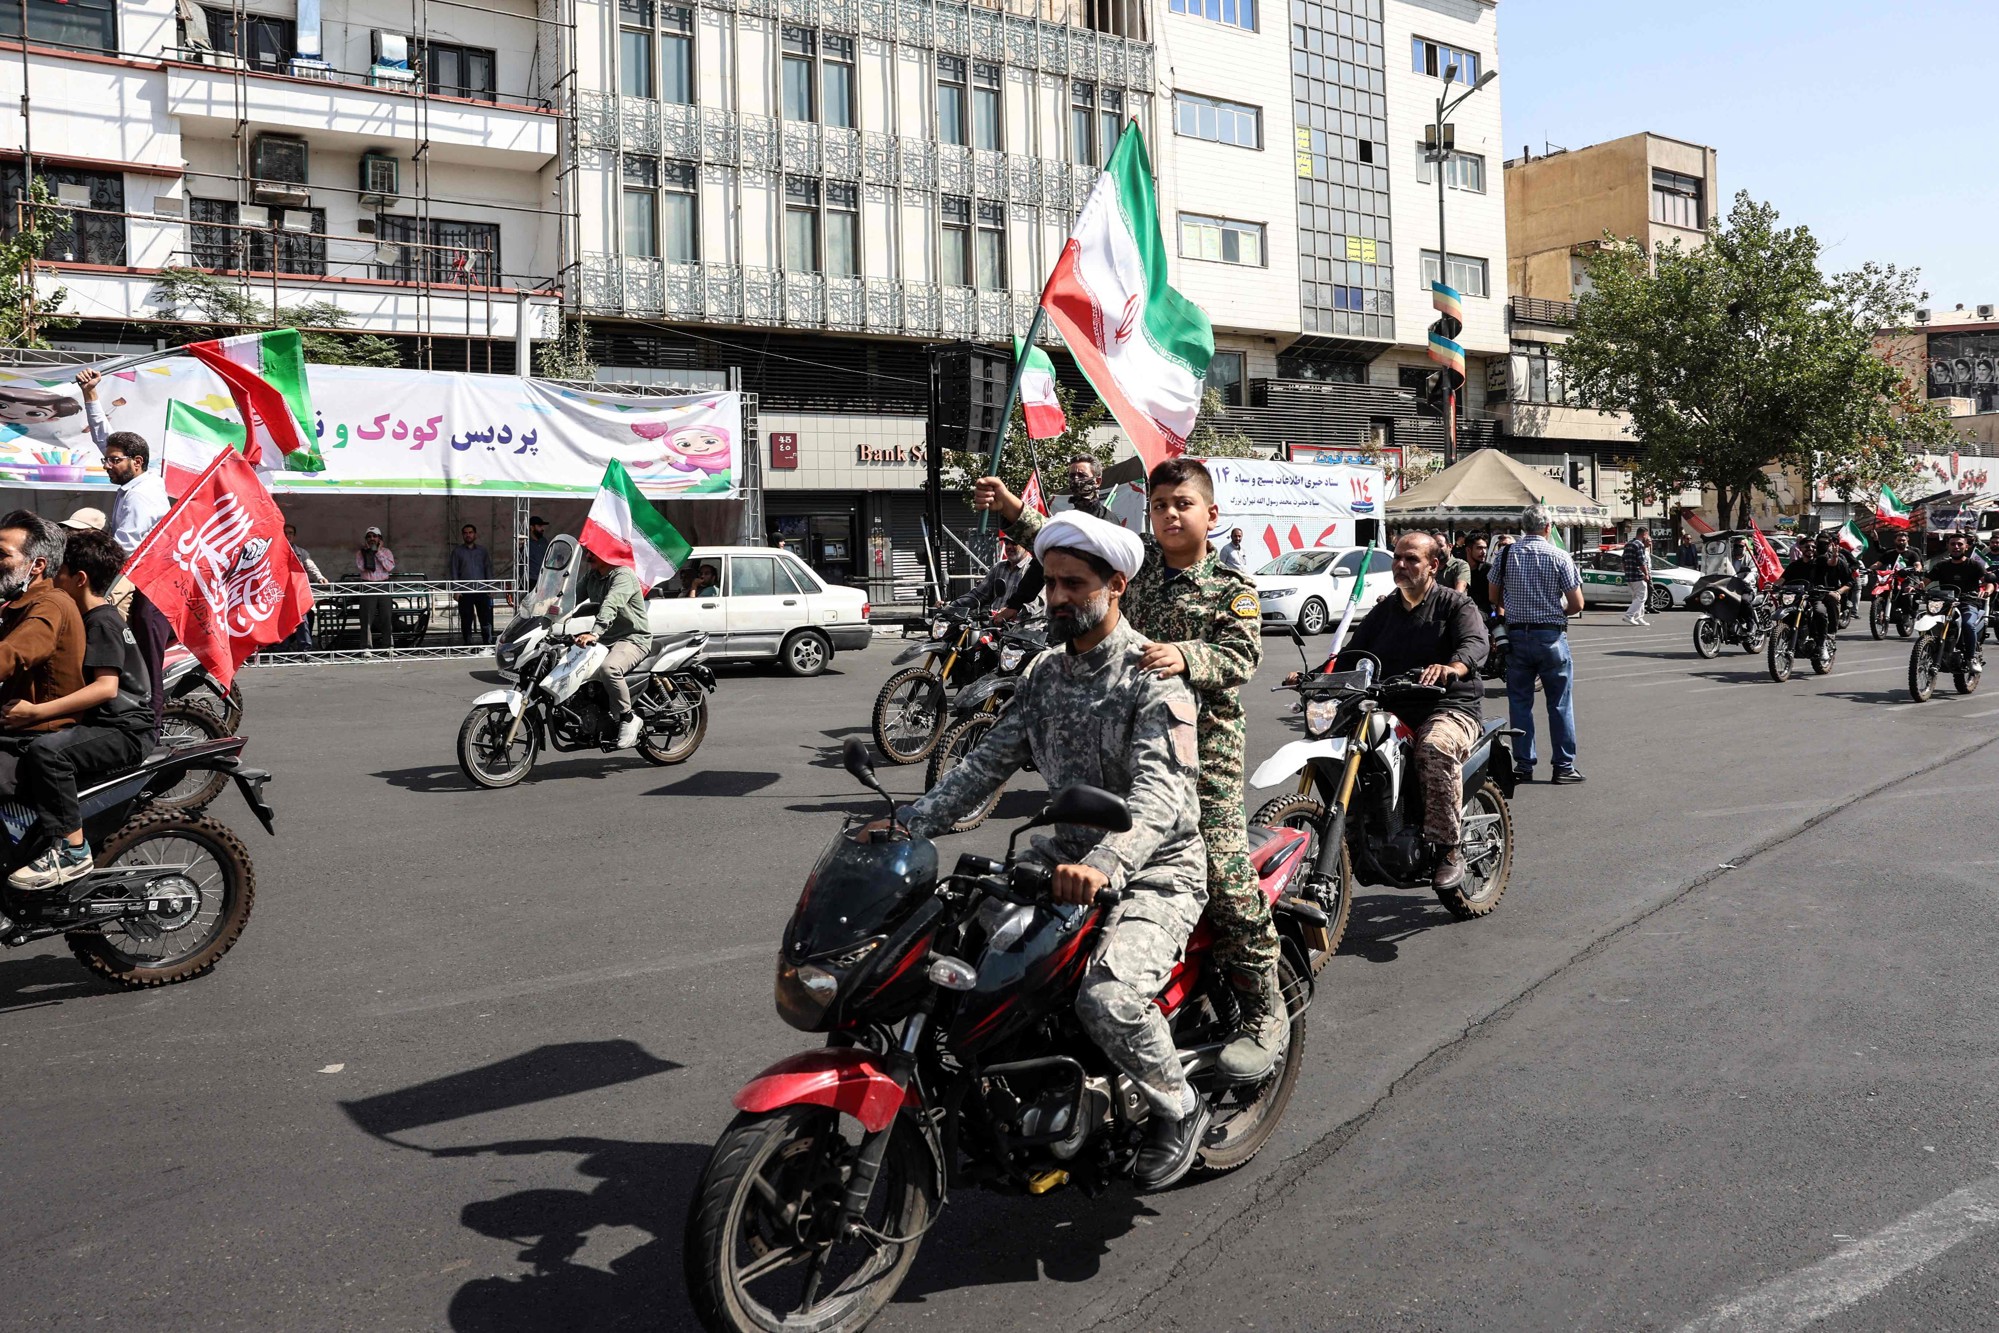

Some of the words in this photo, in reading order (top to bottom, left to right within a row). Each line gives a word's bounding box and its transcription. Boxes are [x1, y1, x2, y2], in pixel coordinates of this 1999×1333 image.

[332, 423, 348, 448] و
[356, 413, 443, 450] کودک
[451, 423, 537, 456] پردیس
[860, 443, 907, 461] Bank
[1257, 477, 1273, 486] بسیج
[1276, 474, 1303, 485] اطلاعات
[1305, 476, 1323, 488] خبری
